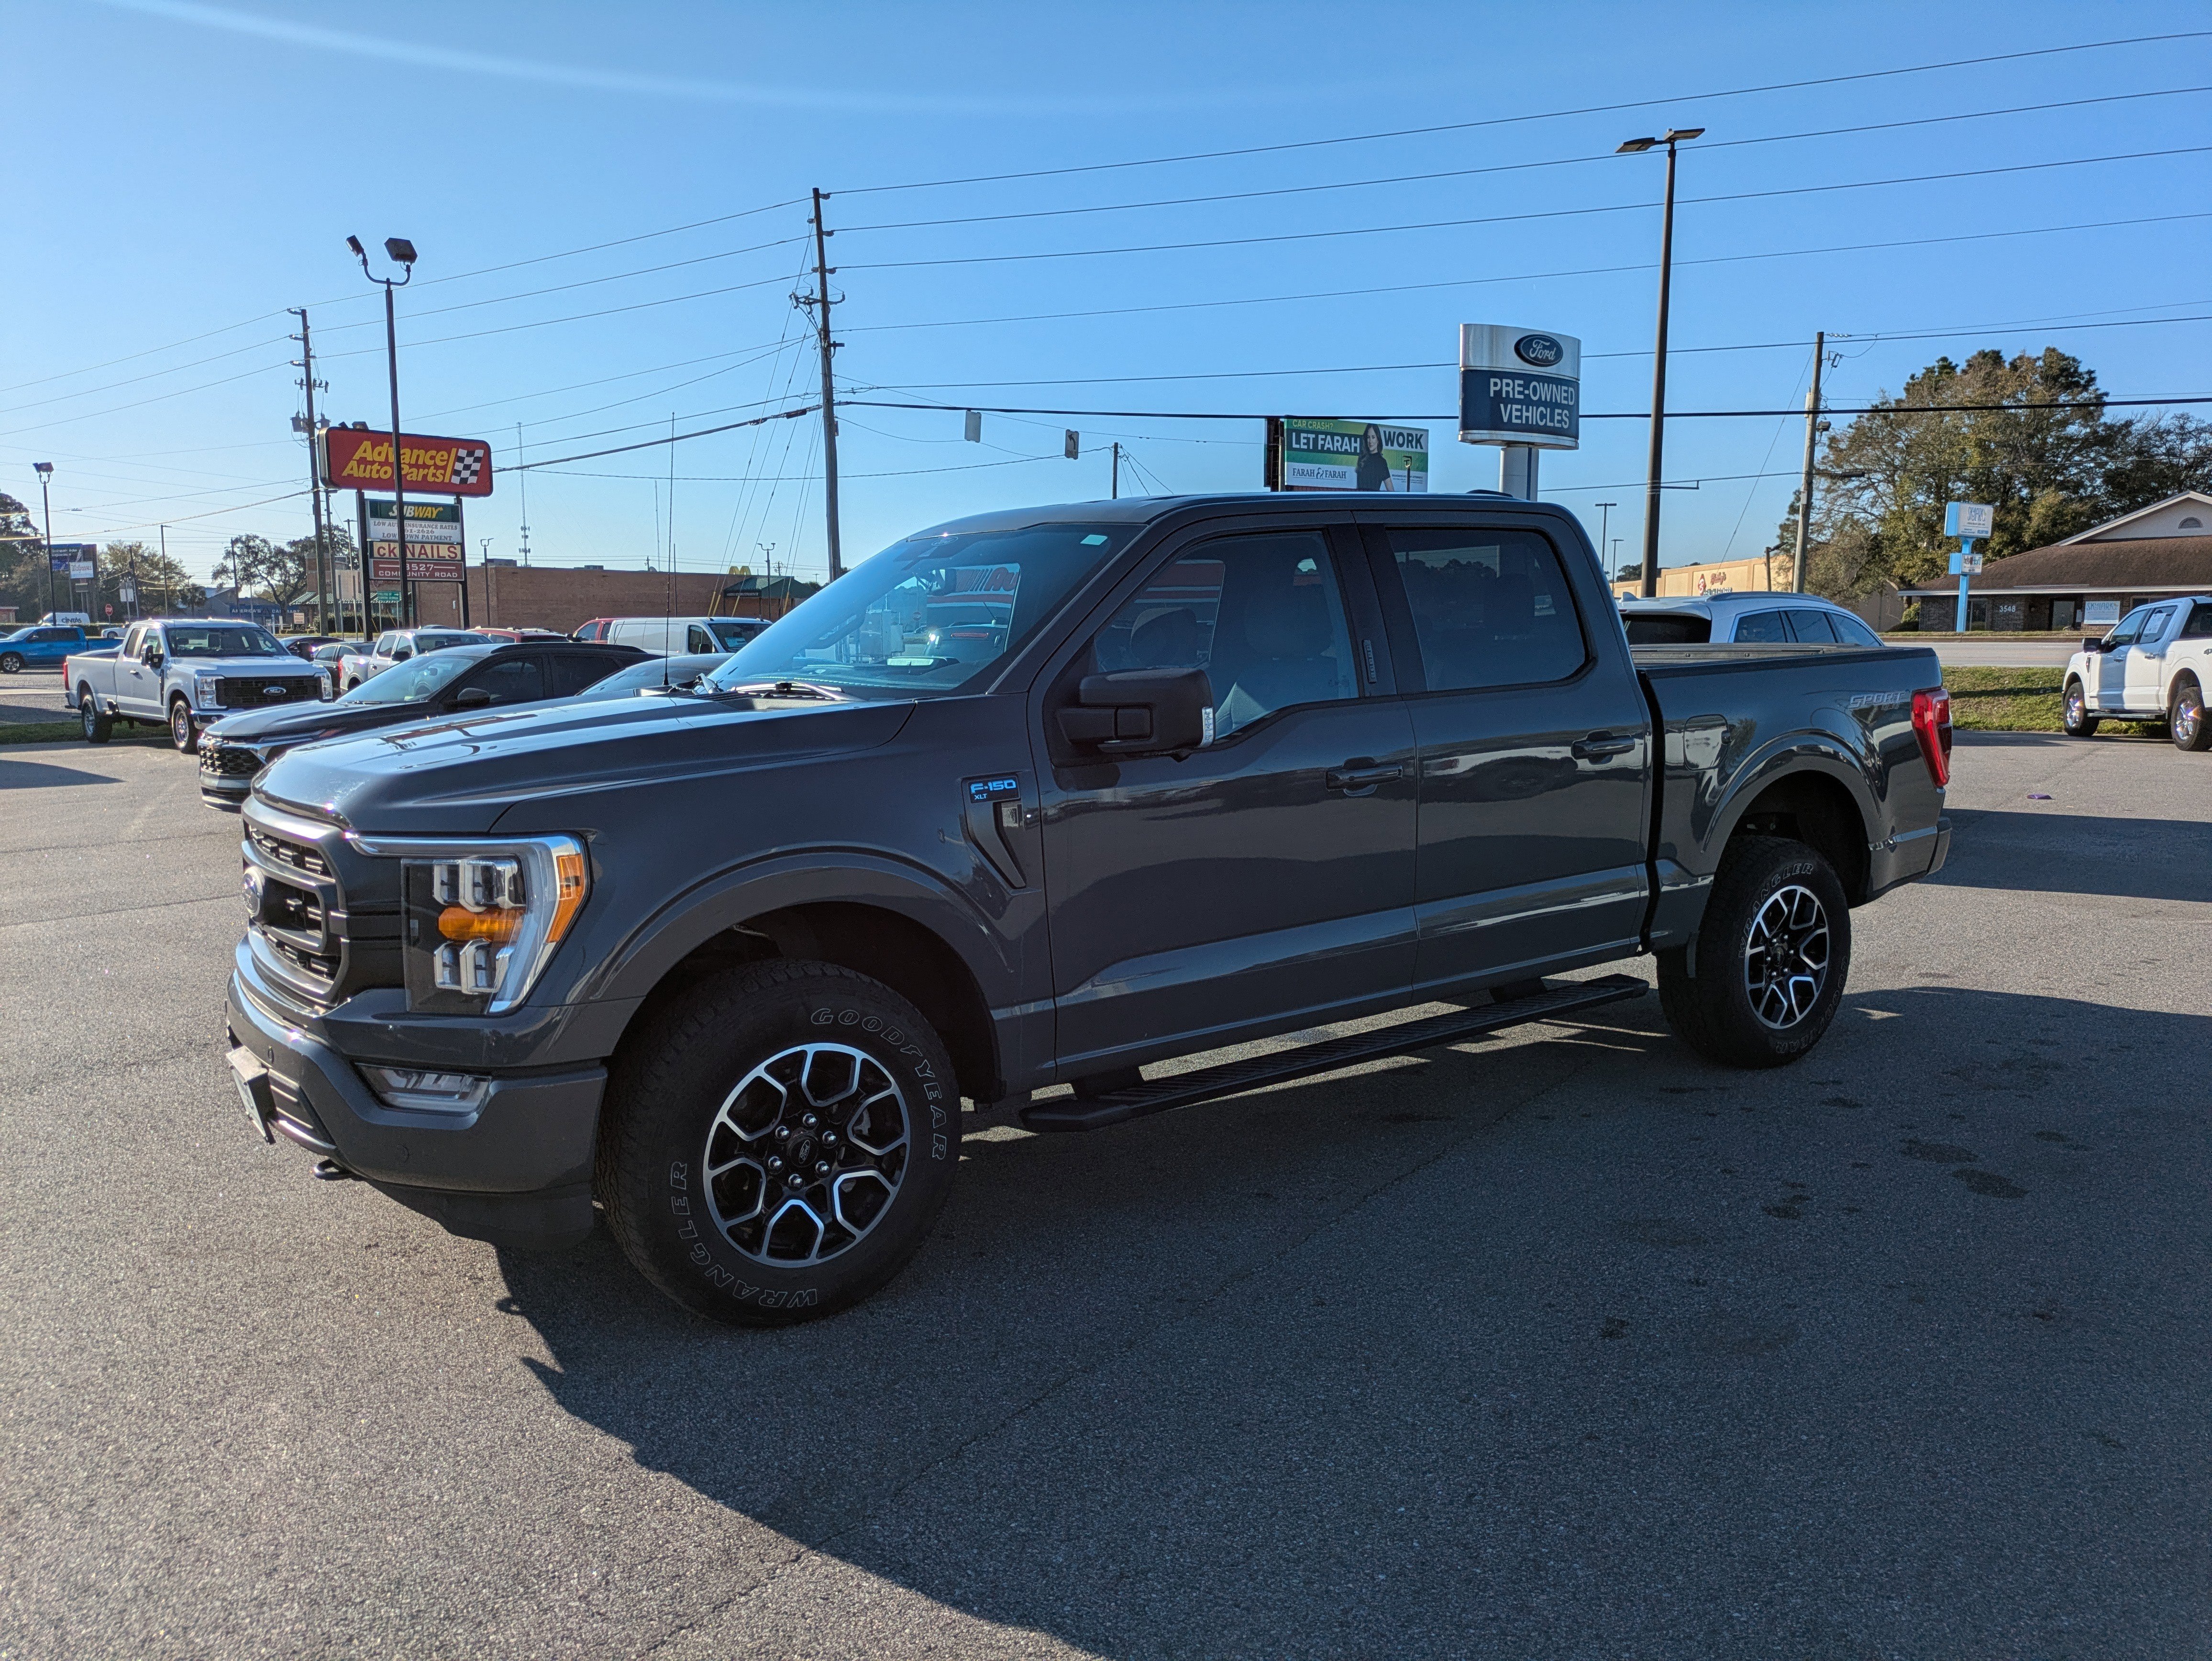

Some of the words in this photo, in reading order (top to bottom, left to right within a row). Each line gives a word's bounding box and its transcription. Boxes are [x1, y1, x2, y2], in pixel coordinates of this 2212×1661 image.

[1529, 339, 1557, 361] Ford
[1490, 378, 1575, 405] PRE-OWNED
[1293, 419, 1306, 428] CAR
[1307, 421, 1334, 431] CRASH?
[1500, 403, 1569, 429] VEHICLES
[1292, 432, 1315, 449] LET
[1318, 434, 1360, 453] FARAH
[1383, 431, 1424, 450] WORK
[342, 460, 392, 479] Auto
[1293, 467, 1315, 477] FARAH
[1325, 469, 1347, 479] FARAH
[406, 544, 458, 559] NAILS
[1848, 690, 1905, 710] SPORT
[970, 779, 1017, 794] F-150
[810, 1008, 947, 1160] GOODYEAR
[670, 1161, 818, 1308] WRANGLER
